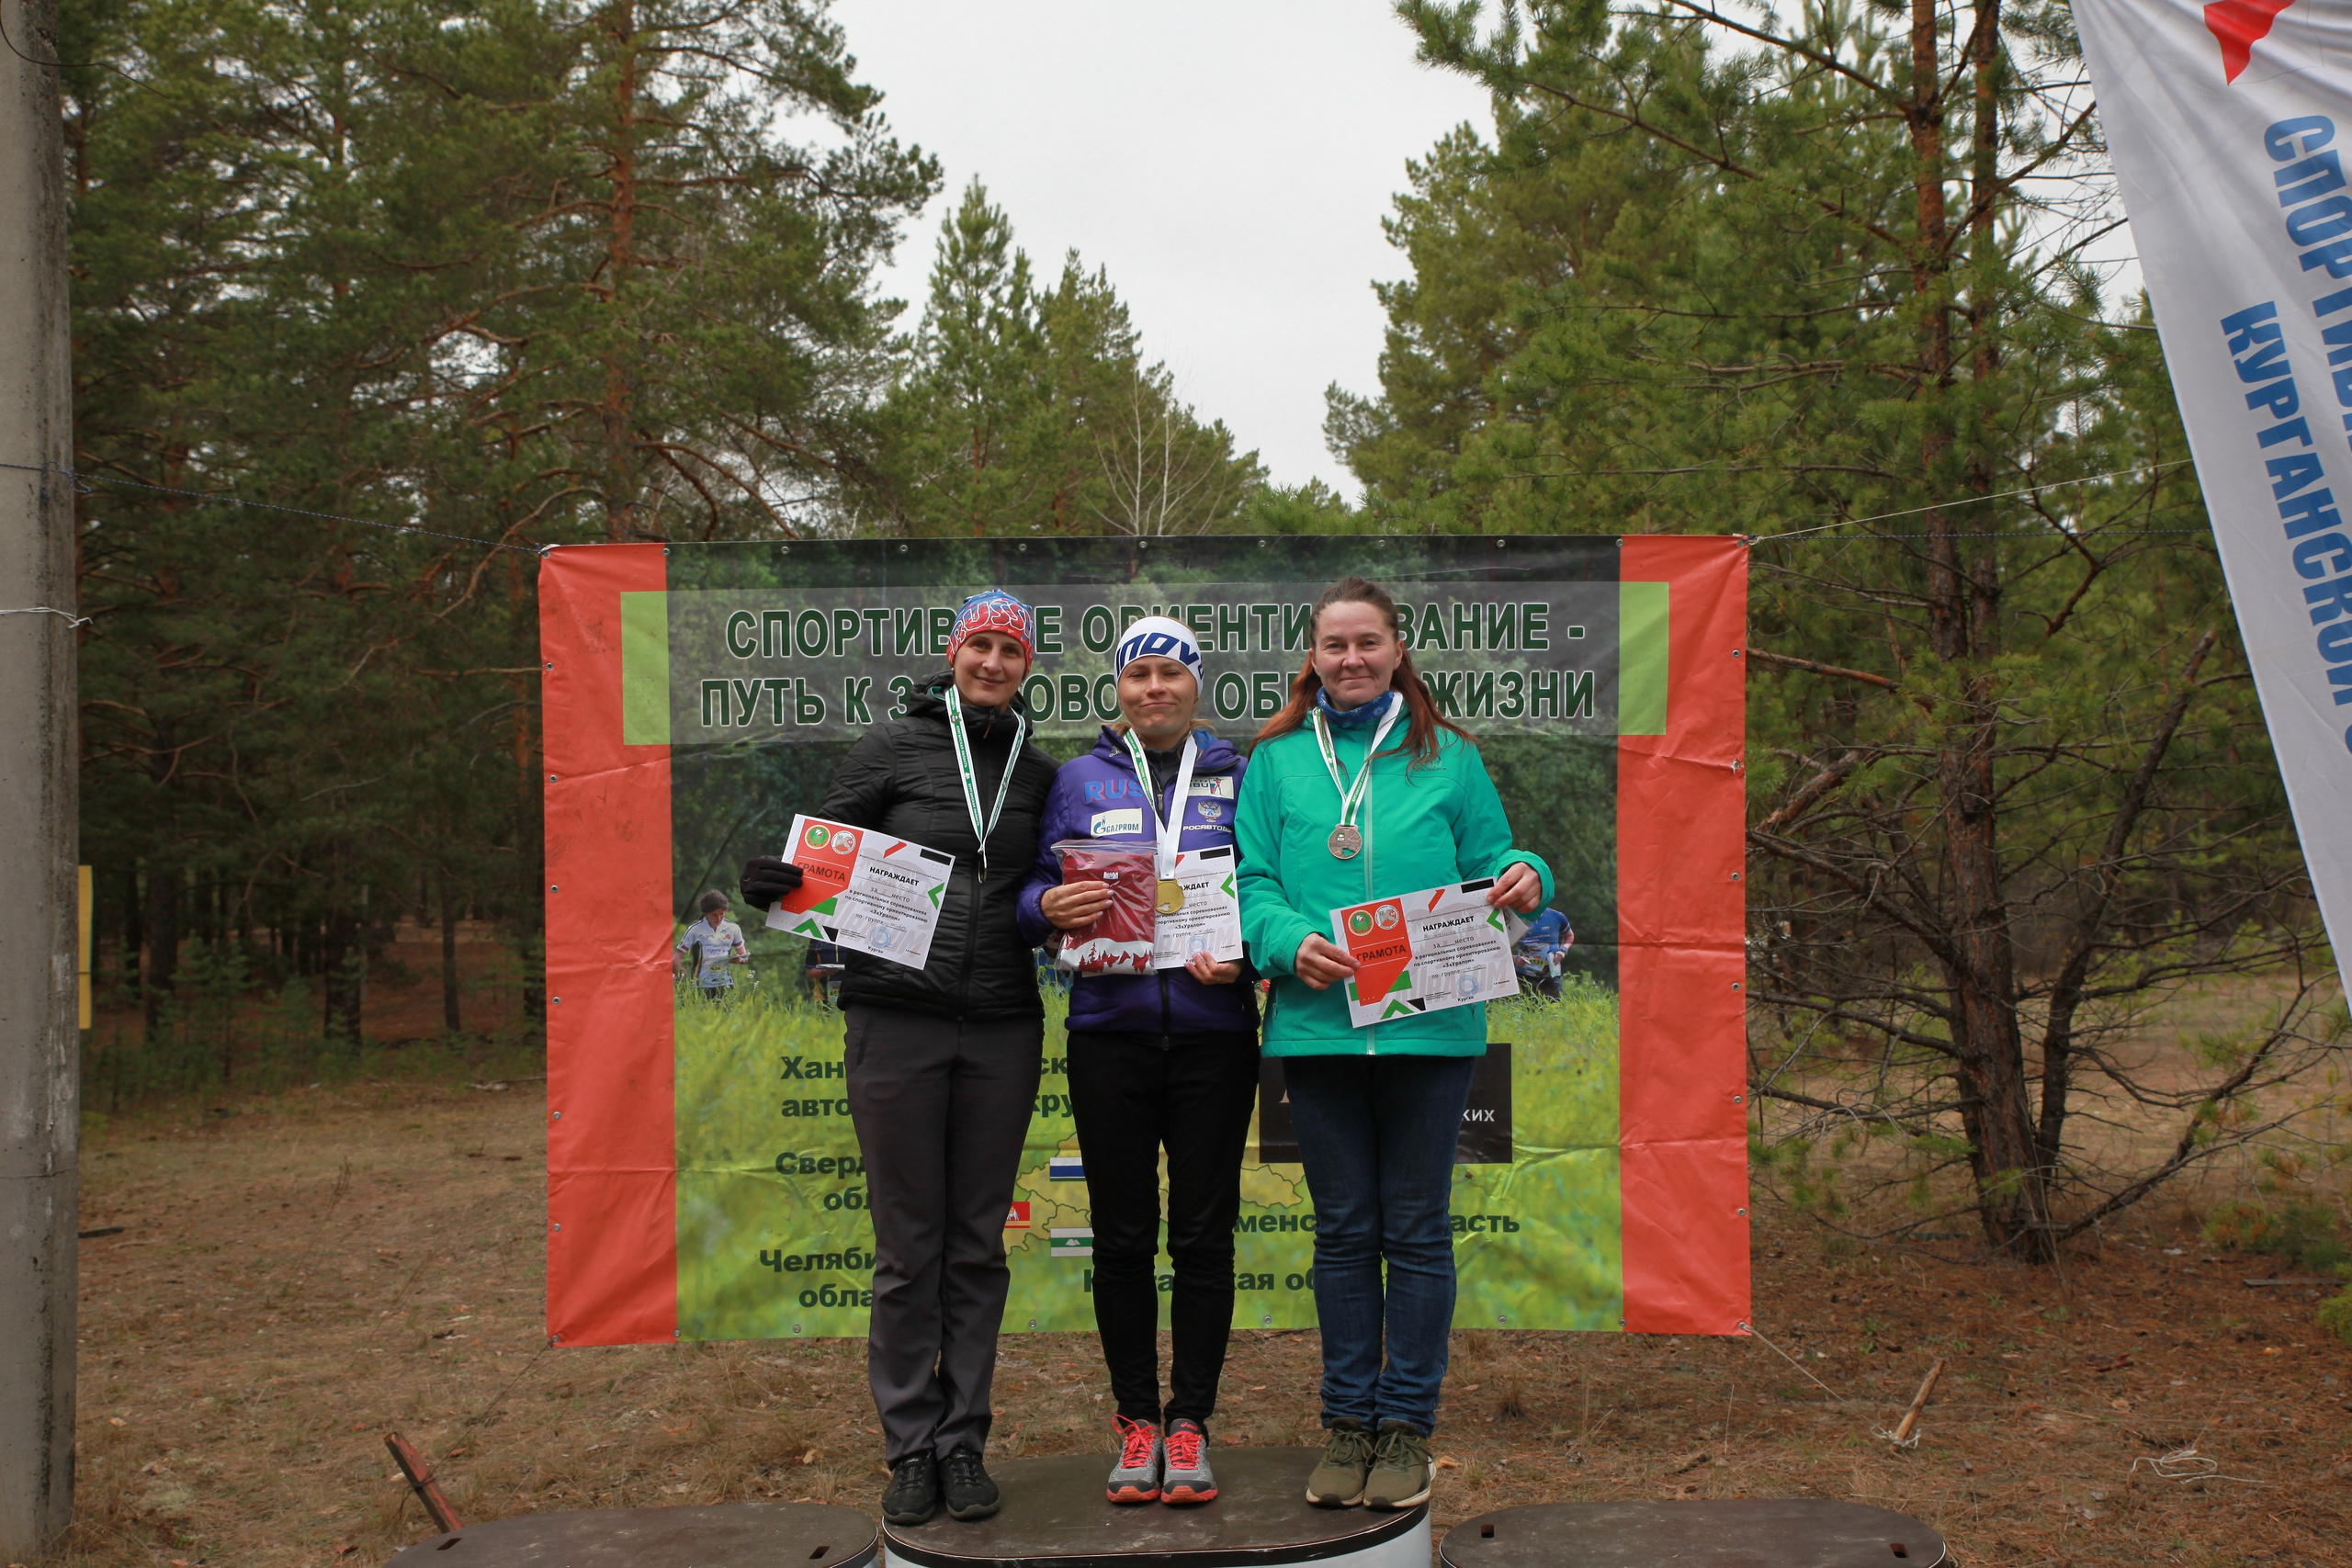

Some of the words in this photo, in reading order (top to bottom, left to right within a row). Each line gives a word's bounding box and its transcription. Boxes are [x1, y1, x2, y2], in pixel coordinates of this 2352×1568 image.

[726, 605, 1064, 659] СПОРТИВЕ
[701, 678, 826, 727] ПУТЬ
[844, 676, 873, 724] К
[1422, 670, 1594, 719] ЖИЗНИ
[1105, 823, 1139, 834] GAZPROM
[869, 866, 920, 886] НАГРАЖДАЕТ
[853, 890, 889, 906] региональных
[889, 901, 927, 916] соревнованиях
[891, 894, 910, 903] место
[852, 897, 886, 911] спортивному
[886, 908, 928, 924] ориентированию
[1190, 906, 1227, 915] соревнованиях
[865, 916, 884, 926] группе
[1189, 911, 1231, 922] ориентированию
[1423, 916, 1476, 932] НАГРАЖДАЕТ
[1454, 936, 1475, 944] место
[867, 946, 884, 954] Курган
[1419, 948, 1456, 960] региональных
[1456, 940, 1497, 952] соревнованиях
[1421, 954, 1455, 966] спортивному
[1456, 946, 1501, 960] ориентированию
[1442, 969, 1461, 977] группе
[1457, 995, 1475, 1003] Курган
